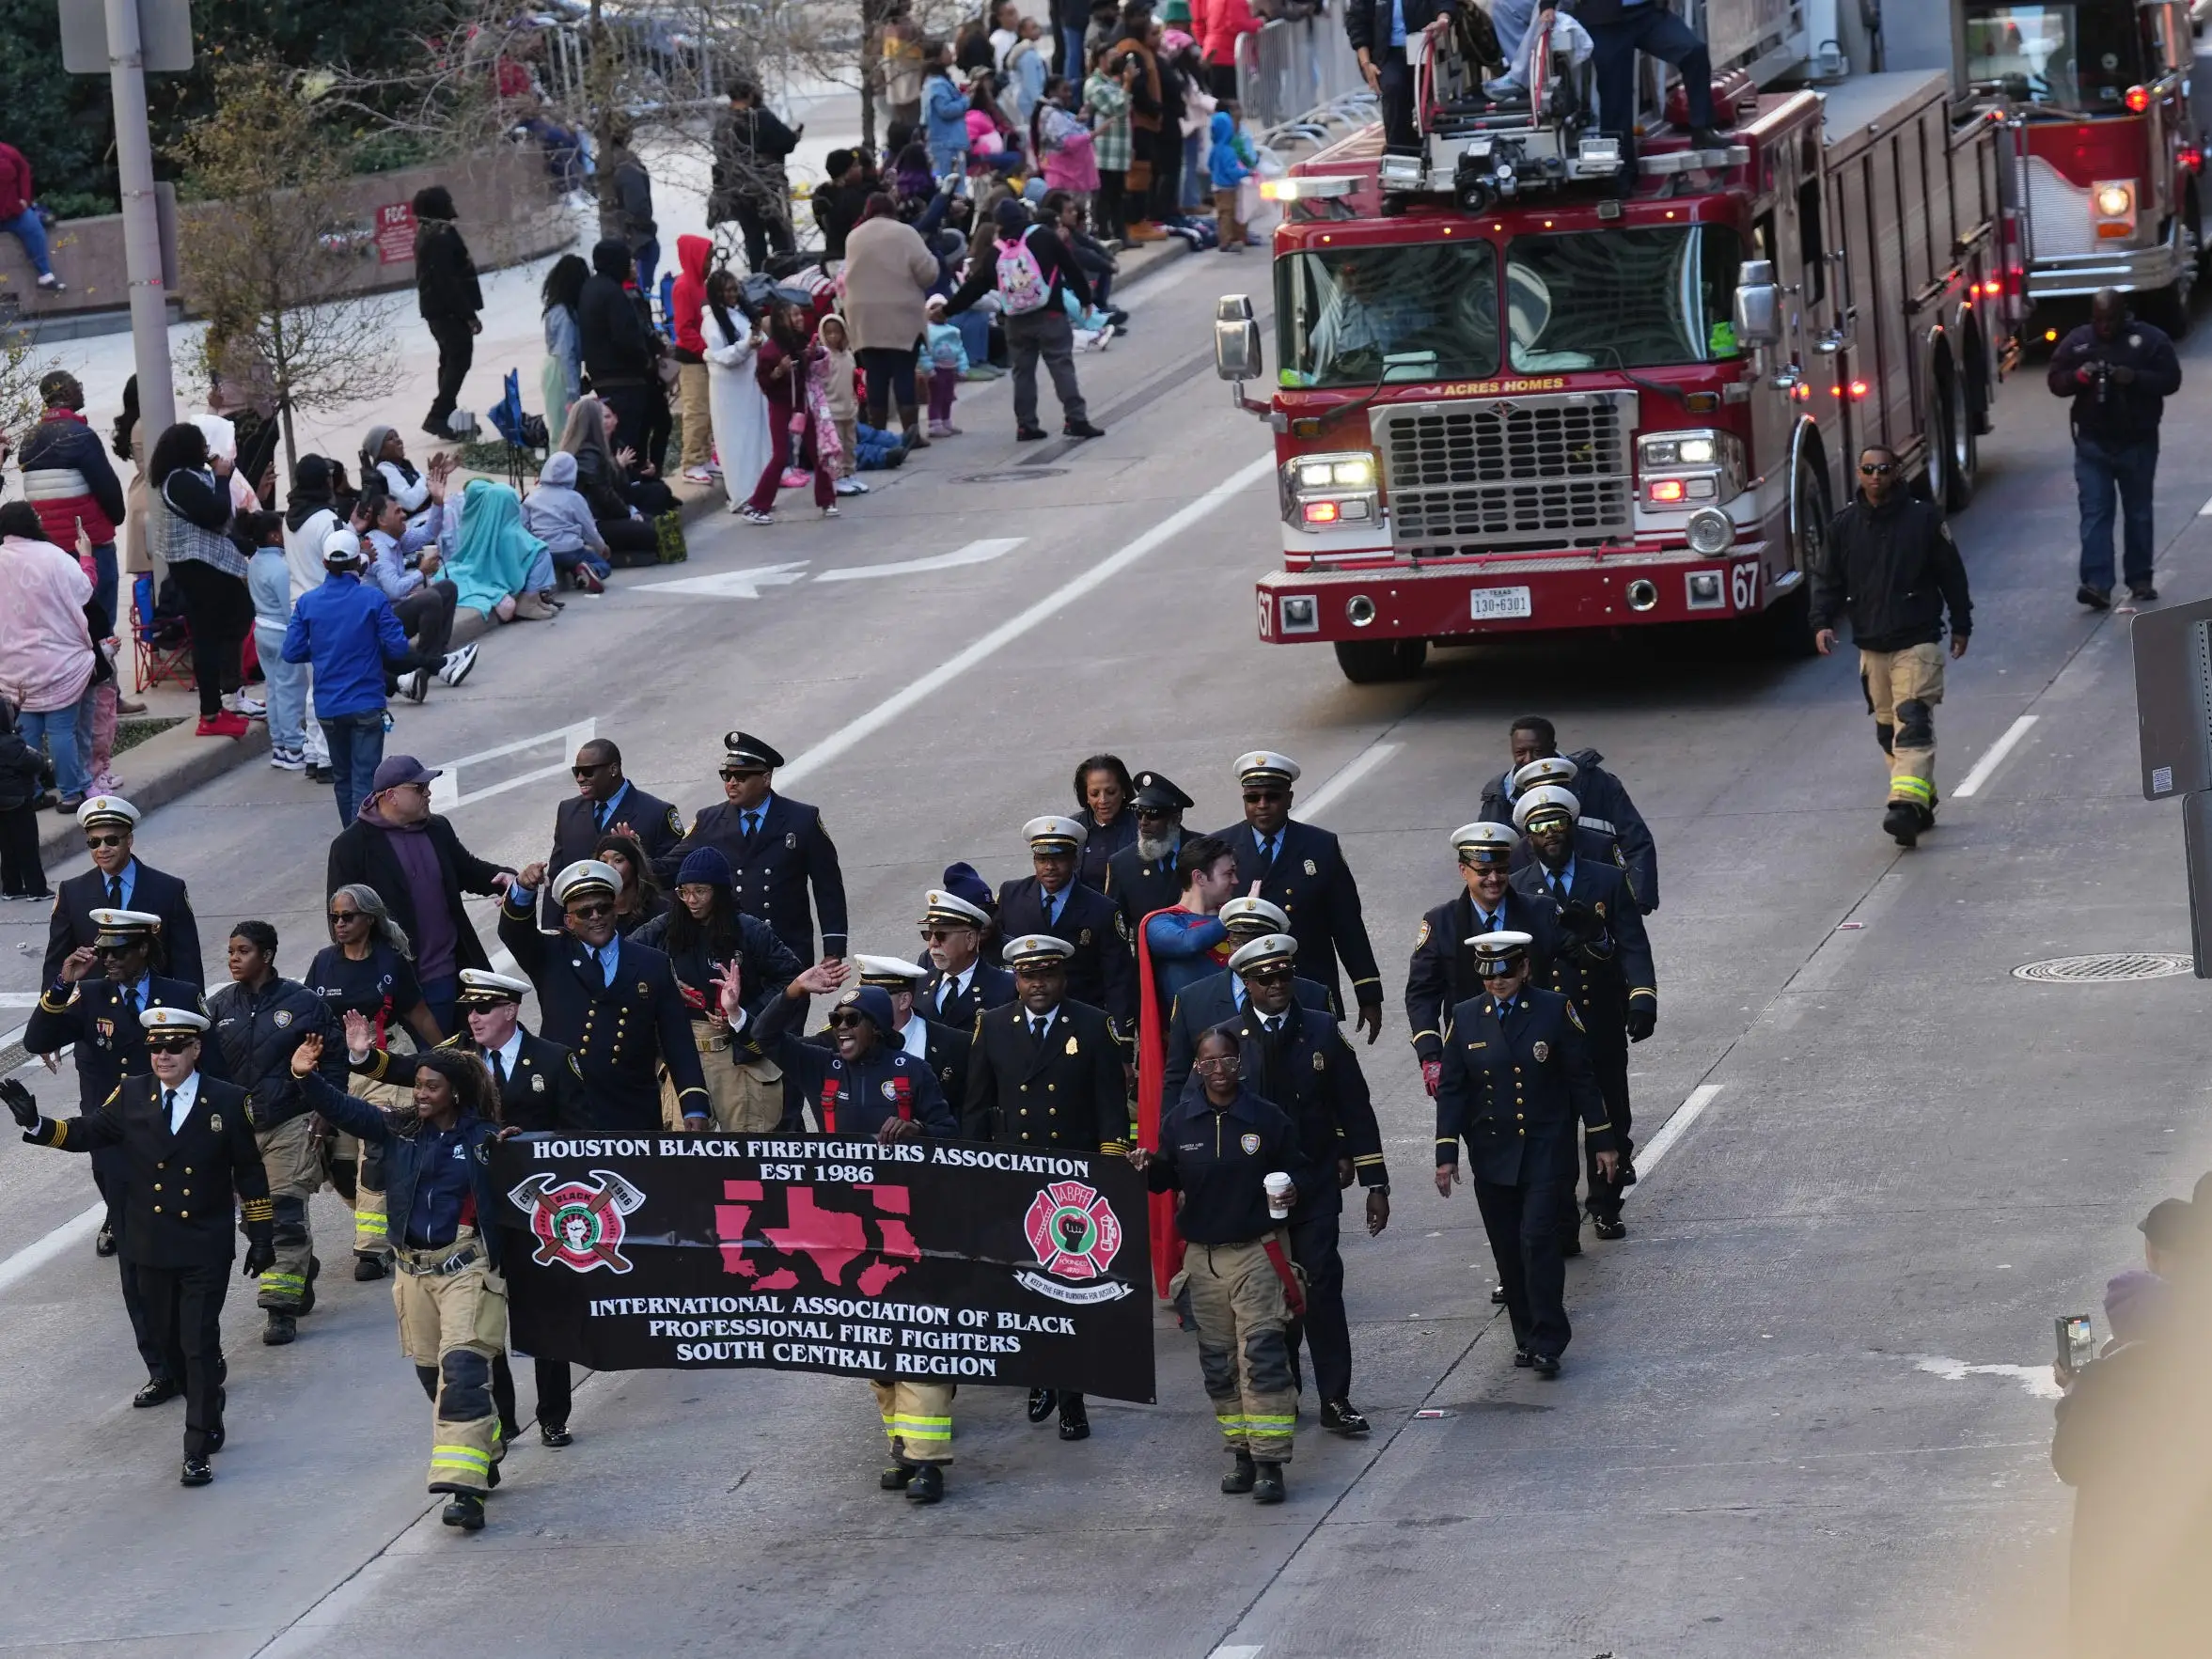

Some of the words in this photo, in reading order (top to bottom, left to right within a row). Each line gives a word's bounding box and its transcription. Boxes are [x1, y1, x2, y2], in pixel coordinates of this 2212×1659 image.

[1444, 382, 1499, 396] ACRES
[1504, 378, 1564, 392] HOMES
[1733, 561, 1759, 610] 67
[1258, 590, 1273, 636] 67
[533, 1139, 651, 1159] HOUSTON
[659, 1139, 741, 1158] BLACK
[746, 1140, 925, 1163] FIREFIGHTERS
[931, 1146, 1090, 1178] ASSOCIATION
[760, 1164, 806, 1181] EST
[814, 1165, 874, 1183] 1986
[556, 1193, 592, 1203] BLACK
[611, 1182, 634, 1206] 1986
[1054, 1185, 1092, 1204] IABPFF
[1030, 1277, 1043, 1288] KEEP
[1043, 1284, 1053, 1294] THE
[1053, 1288, 1064, 1297] FIRE
[1065, 1291, 1089, 1300] BURNING
[1089, 1291, 1098, 1300] FOR
[1098, 1286, 1117, 1298] JUSTICE
[589, 1295, 785, 1317] INTERNATIONAL
[792, 1296, 950, 1326] ASSOCIATION
[957, 1308, 989, 1328] OF
[996, 1311, 1076, 1336] BLACK
[650, 1319, 834, 1339] PROFESSIONAL
[839, 1323, 893, 1345] FIRE
[901, 1329, 1022, 1354] FIGHTERS
[676, 1341, 766, 1361] SOUTH
[773, 1343, 887, 1371] CENTRAL
[895, 1353, 997, 1377] REGION
